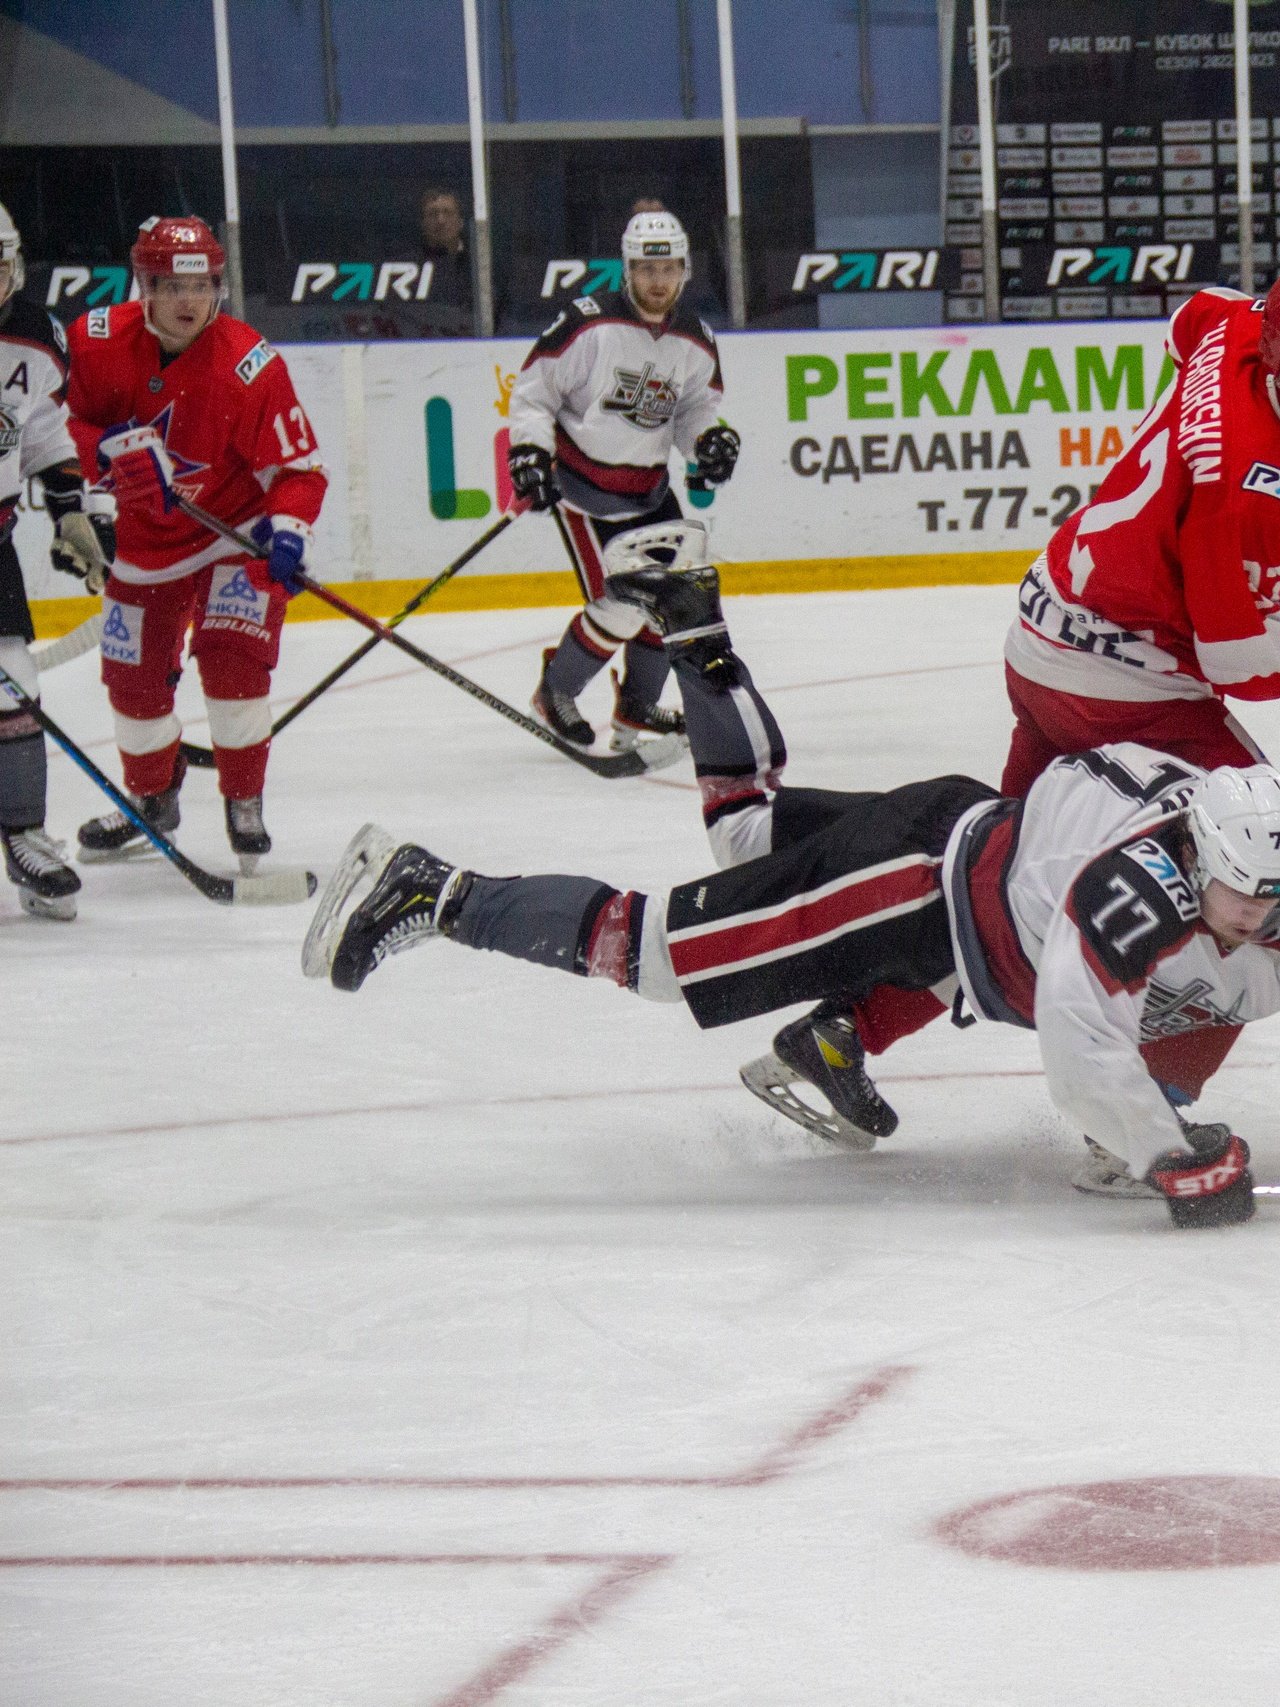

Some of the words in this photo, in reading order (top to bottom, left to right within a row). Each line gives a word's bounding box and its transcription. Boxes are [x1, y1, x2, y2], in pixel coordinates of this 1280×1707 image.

[1154, 33, 1214, 51] КУБОК
[291, 262, 434, 301] PARI
[792, 251, 938, 291] PARI
[1047, 244, 1194, 285] PARI
[5, 360, 28, 394] A
[789, 429, 1031, 483] СДЕЛАНА
[918, 482, 1102, 533] т.77-2
[202, 618, 272, 643] BAUER
[1130, 839, 1200, 920] PARI
[1091, 874, 1162, 957] 77
[1174, 1153, 1239, 1196] STX
